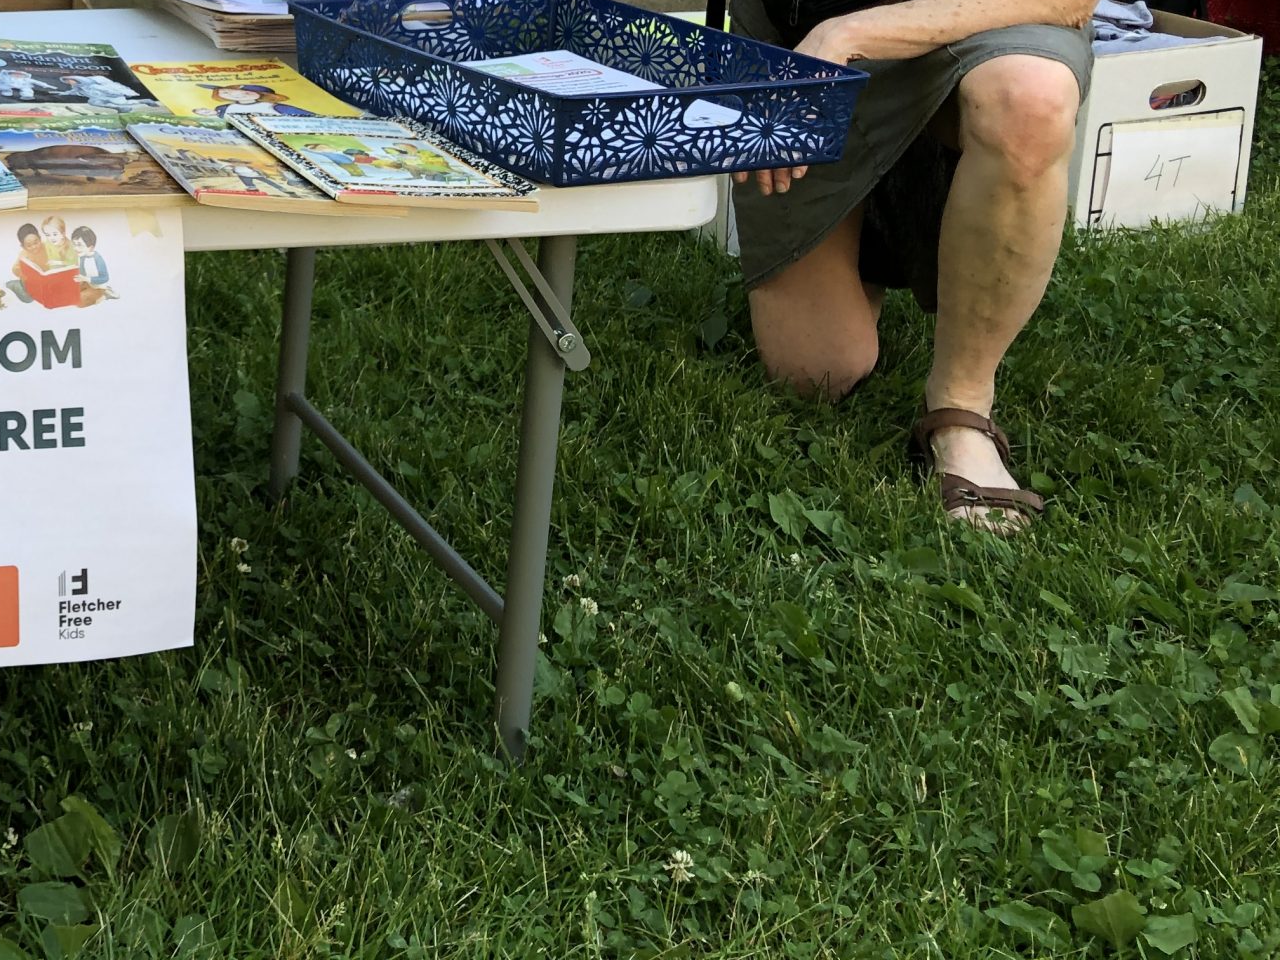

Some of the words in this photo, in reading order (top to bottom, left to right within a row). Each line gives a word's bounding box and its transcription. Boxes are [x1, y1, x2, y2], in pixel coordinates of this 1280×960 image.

[10, 53, 91, 64] Midnight
[58, 62, 113, 71] Moon
[1144, 153, 1192, 192] 4T
[58, 598, 122, 614] Fletcher
[58, 615, 93, 628] Free
[58, 628, 86, 640] Kids
